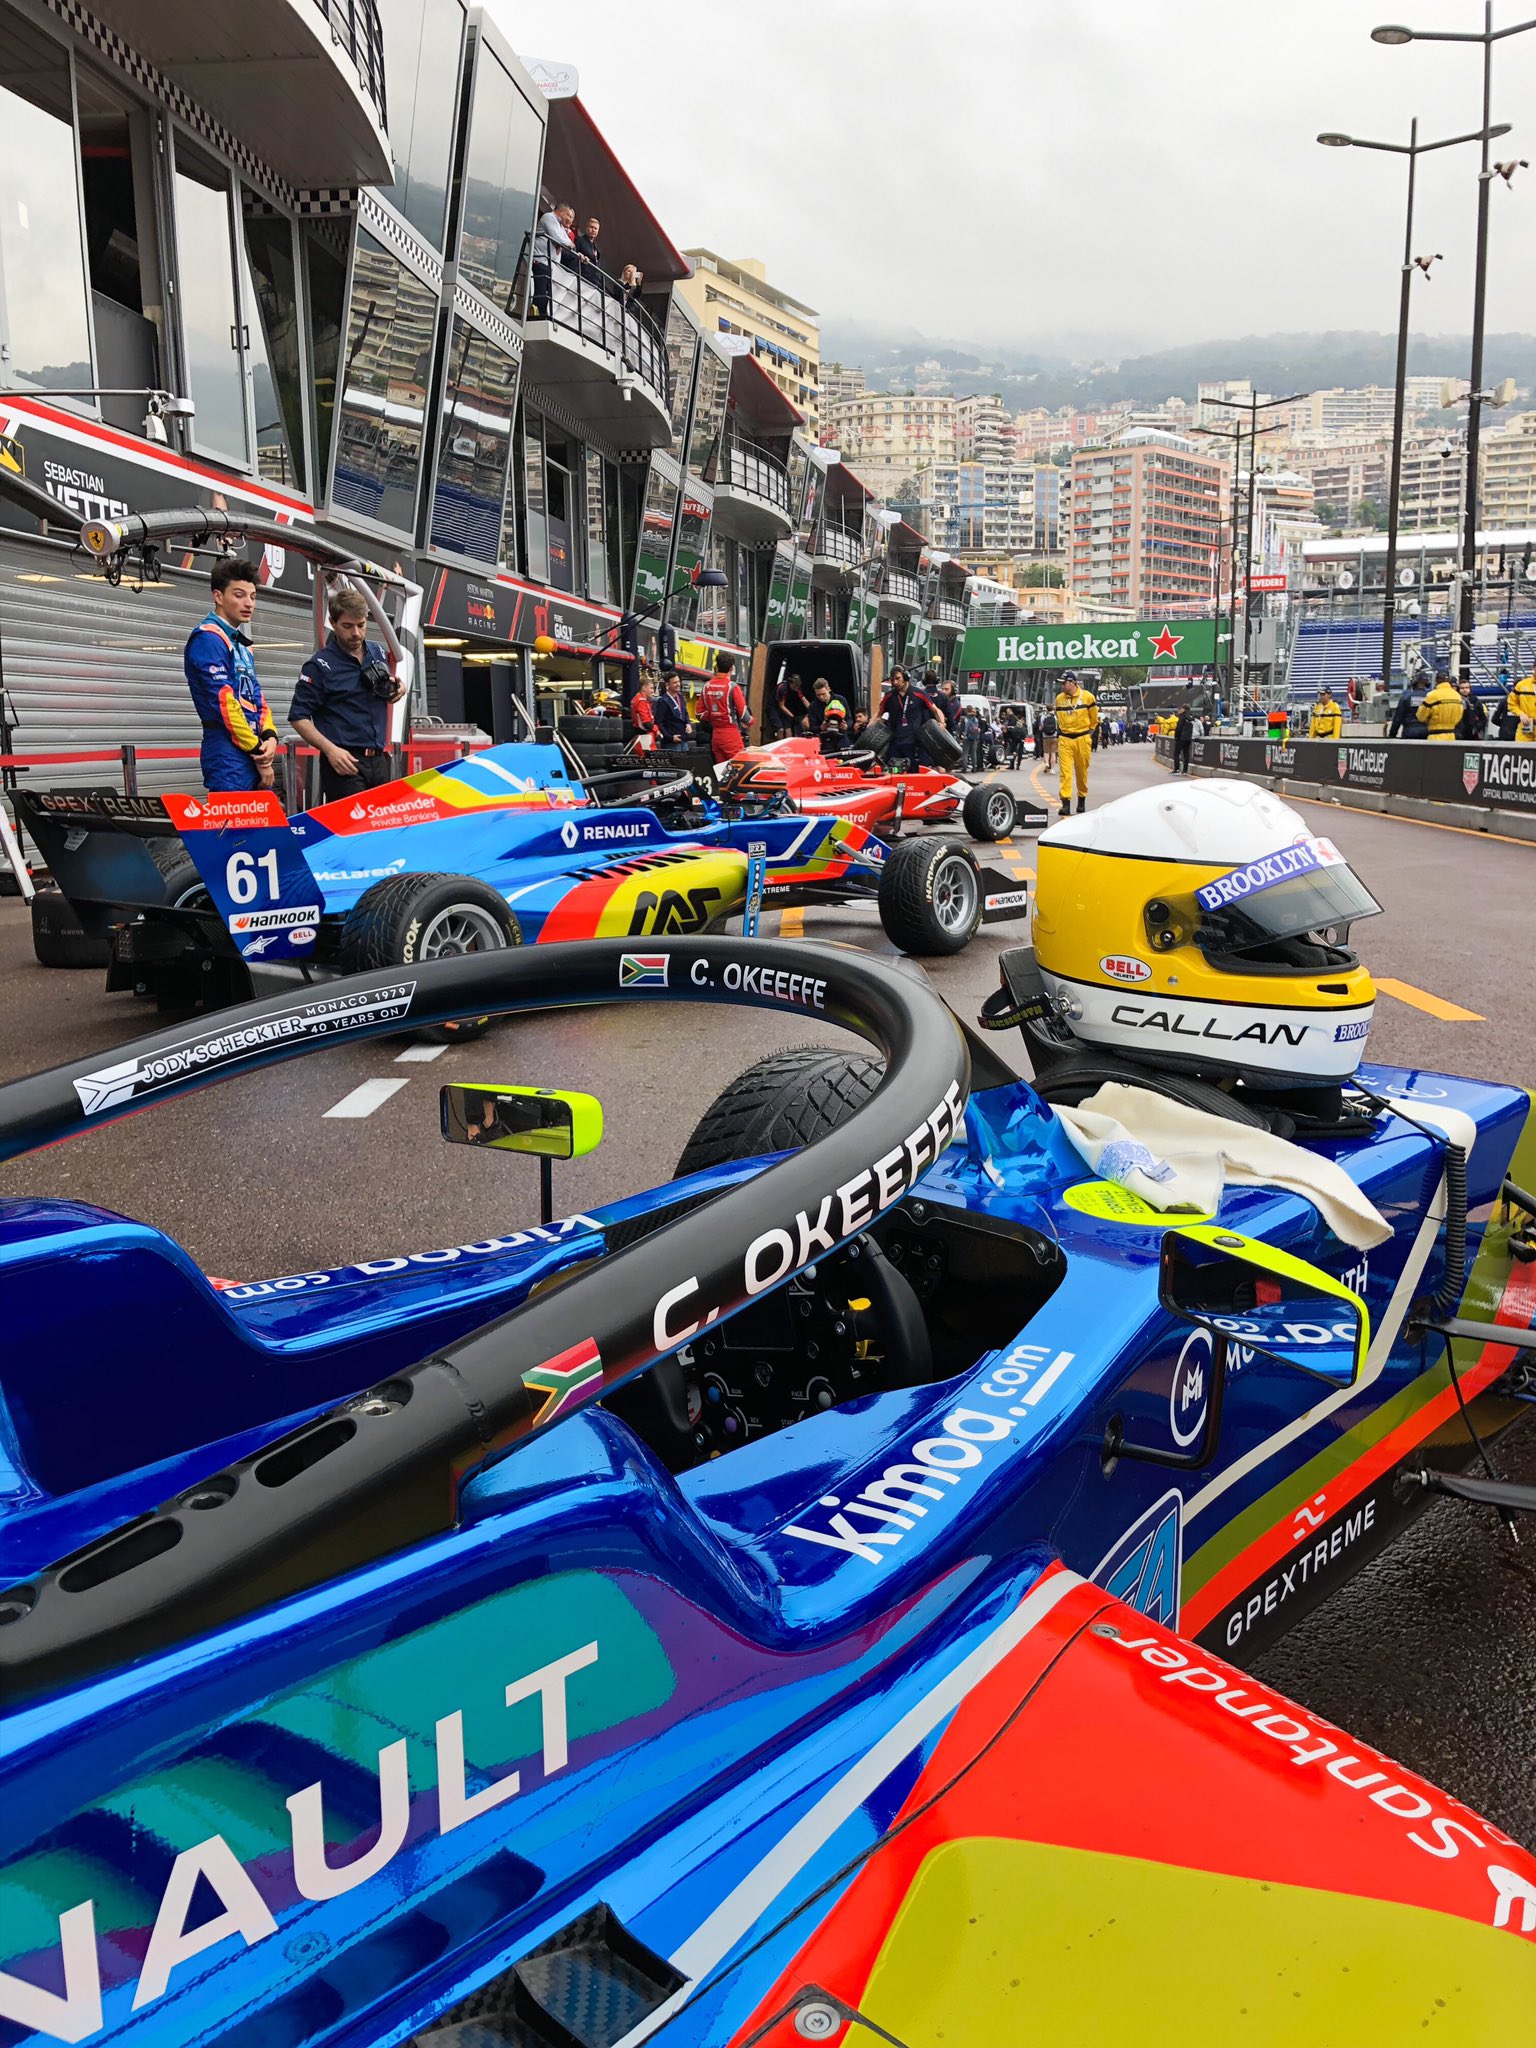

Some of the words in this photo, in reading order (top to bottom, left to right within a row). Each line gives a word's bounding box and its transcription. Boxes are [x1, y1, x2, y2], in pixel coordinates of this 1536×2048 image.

[43, 460, 104, 494] SEBASTIAN
[1250, 577, 1285, 588] ELVEDERE
[467, 617, 497, 631] RACING
[554, 622, 573, 641] GASLY
[202, 801, 270, 817] Santander
[367, 797, 436, 819] Santander
[371, 817, 402, 829] Private
[403, 811, 440, 825] Banking
[203, 819, 230, 829] Private
[235, 816, 269, 828] Banking
[583, 823, 651, 840] RENAULT
[226, 848, 281, 905] 61
[312, 865, 400, 881] McLaren
[1198, 844, 1313, 911] BROOKLYN
[293, 930, 313, 940] BELL
[1105, 958, 1145, 977] BELL
[690, 958, 715, 988] C.
[723, 964, 827, 1009] OKEEFFE
[305, 994, 368, 1016] MONACO
[374, 985, 406, 1001] 1979
[310, 1022, 327, 1034] 40
[332, 1011, 376, 1029] YEARS
[379, 1006, 400, 1018] ON
[1111, 1005, 1310, 1046] CALLAN
[142, 1052, 191, 1084] JODY
[195, 1016, 304, 1062] SCHECKTER
[653, 1275, 720, 1352] C.
[744, 1078, 963, 1296] OKEEFFE
[780, 1344, 1075, 1566] kimoa.com
[1225, 1498, 1377, 1648] GPEXTREME
[1113, 1636, 1487, 1860] Santander
